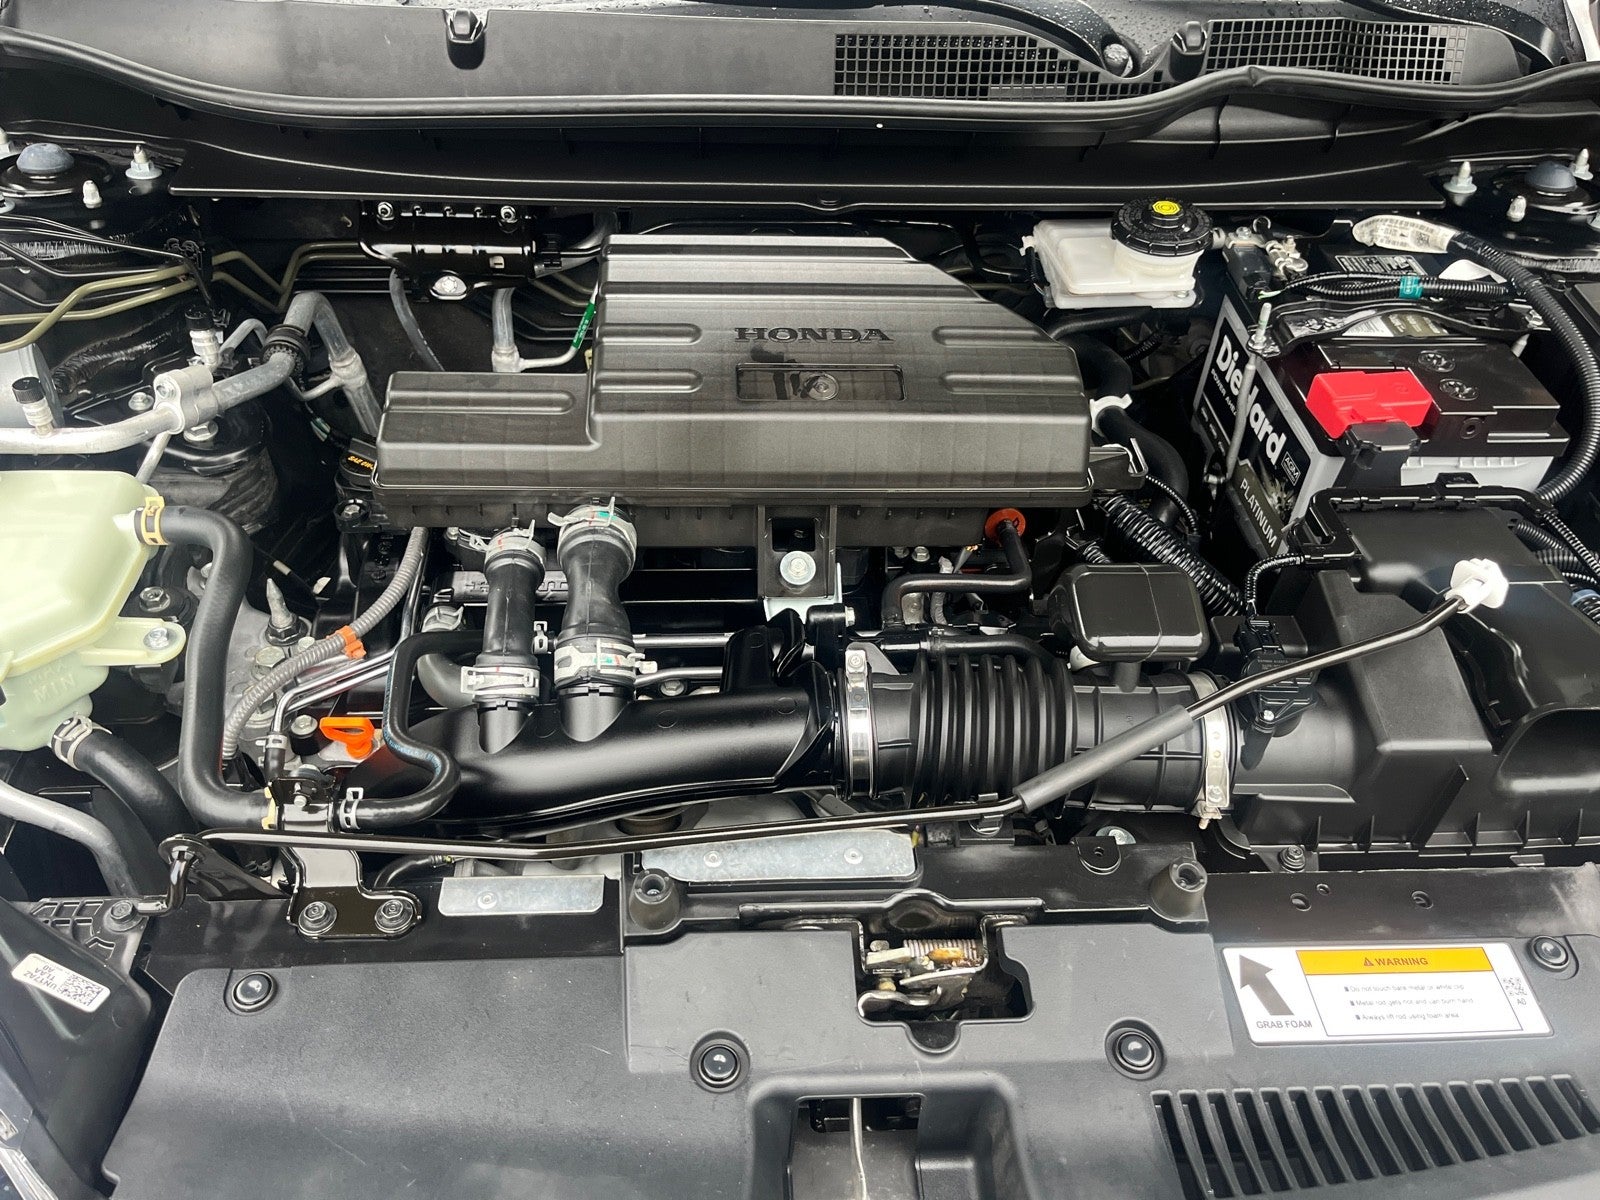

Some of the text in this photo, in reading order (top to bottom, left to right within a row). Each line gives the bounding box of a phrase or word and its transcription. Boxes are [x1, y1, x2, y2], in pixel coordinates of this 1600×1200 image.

[734, 327, 895, 343] HONDA
[1284, 456, 1299, 479] AGM
[1239, 478, 1278, 548] PLATINUM
[1375, 957, 1429, 966] WARNING
[1256, 1020, 1313, 1029] GRAB FOAM
